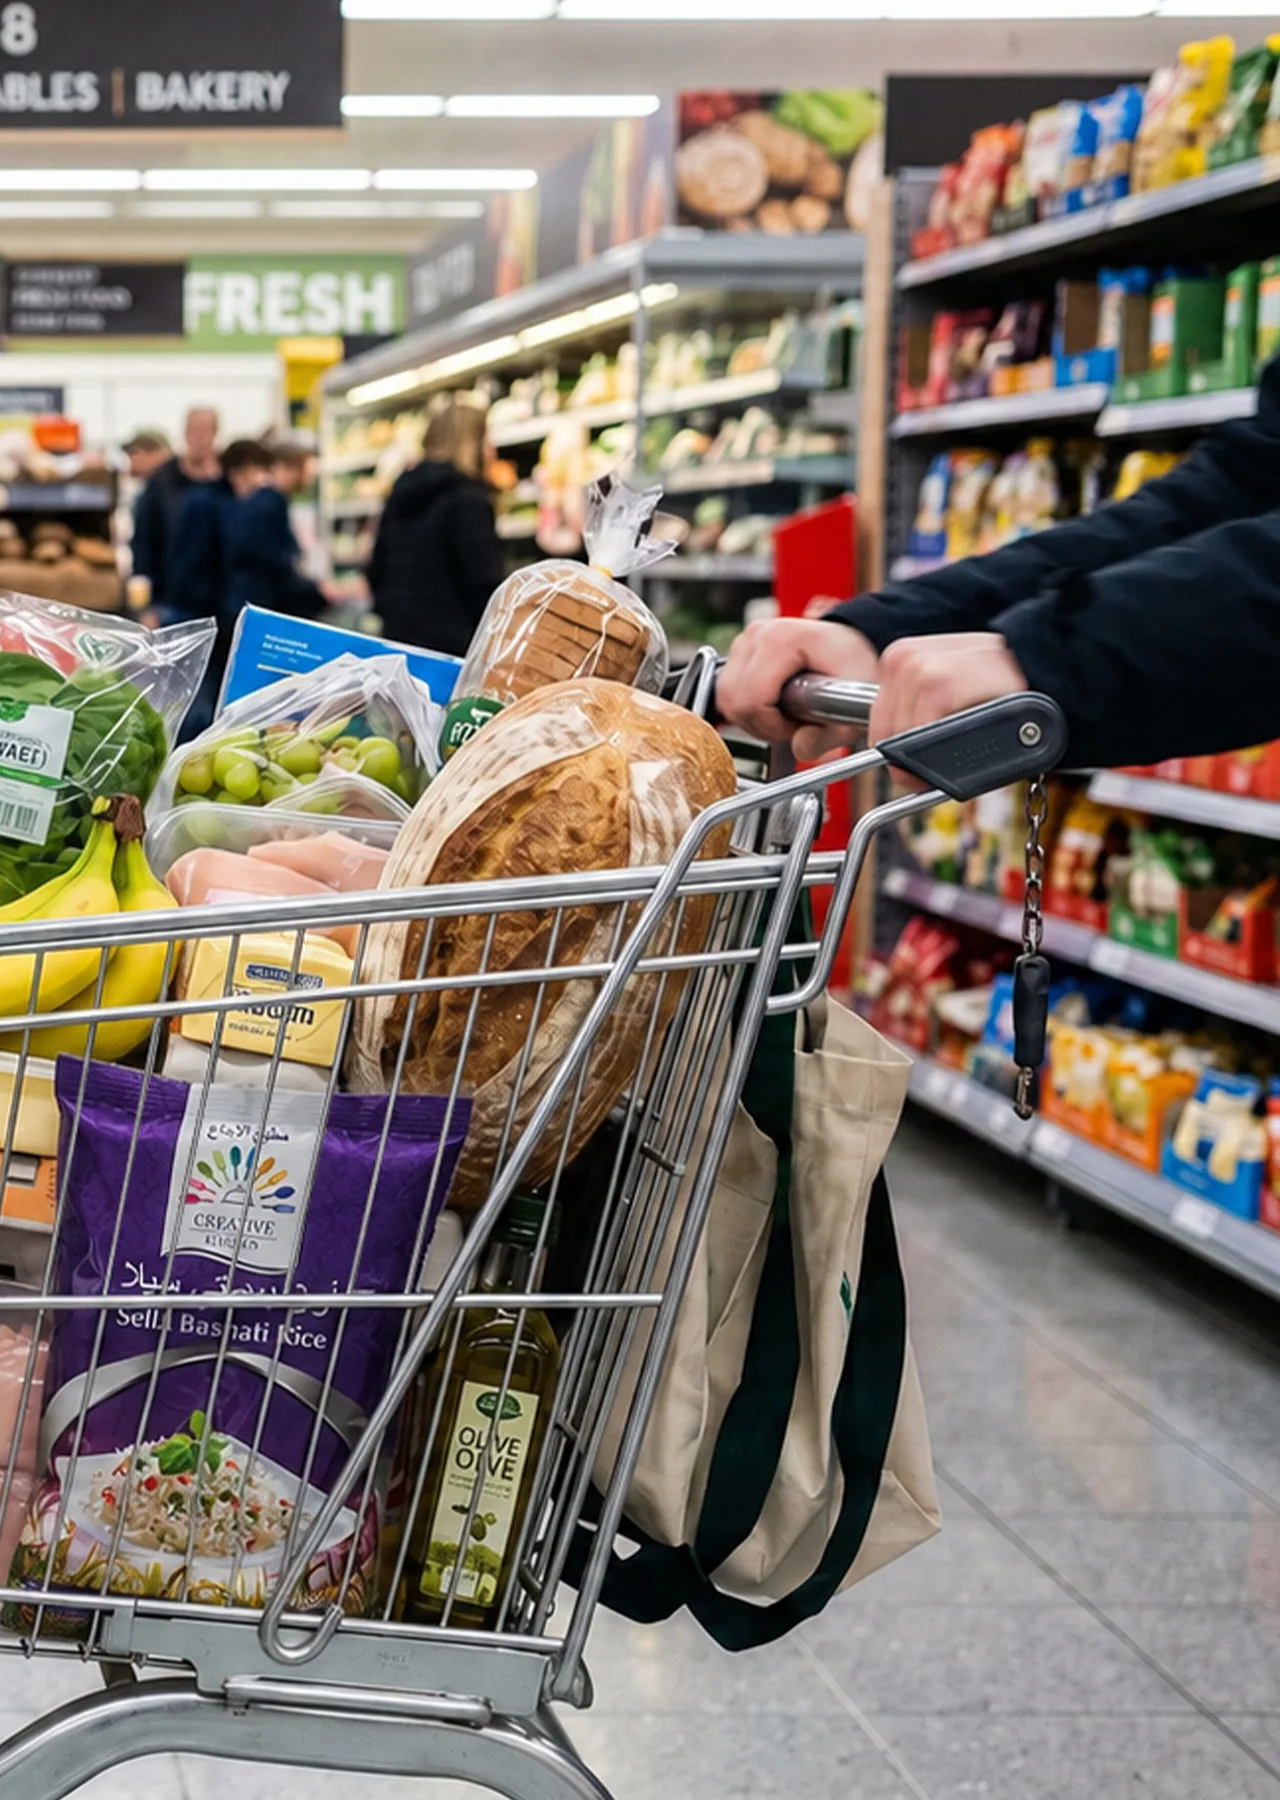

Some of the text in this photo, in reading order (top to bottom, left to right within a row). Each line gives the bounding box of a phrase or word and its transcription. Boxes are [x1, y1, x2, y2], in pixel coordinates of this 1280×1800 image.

[134, 70, 292, 113] BAKERY
[184, 271, 394, 334] FRESH
[459, 1427, 522, 1457] OLVE
